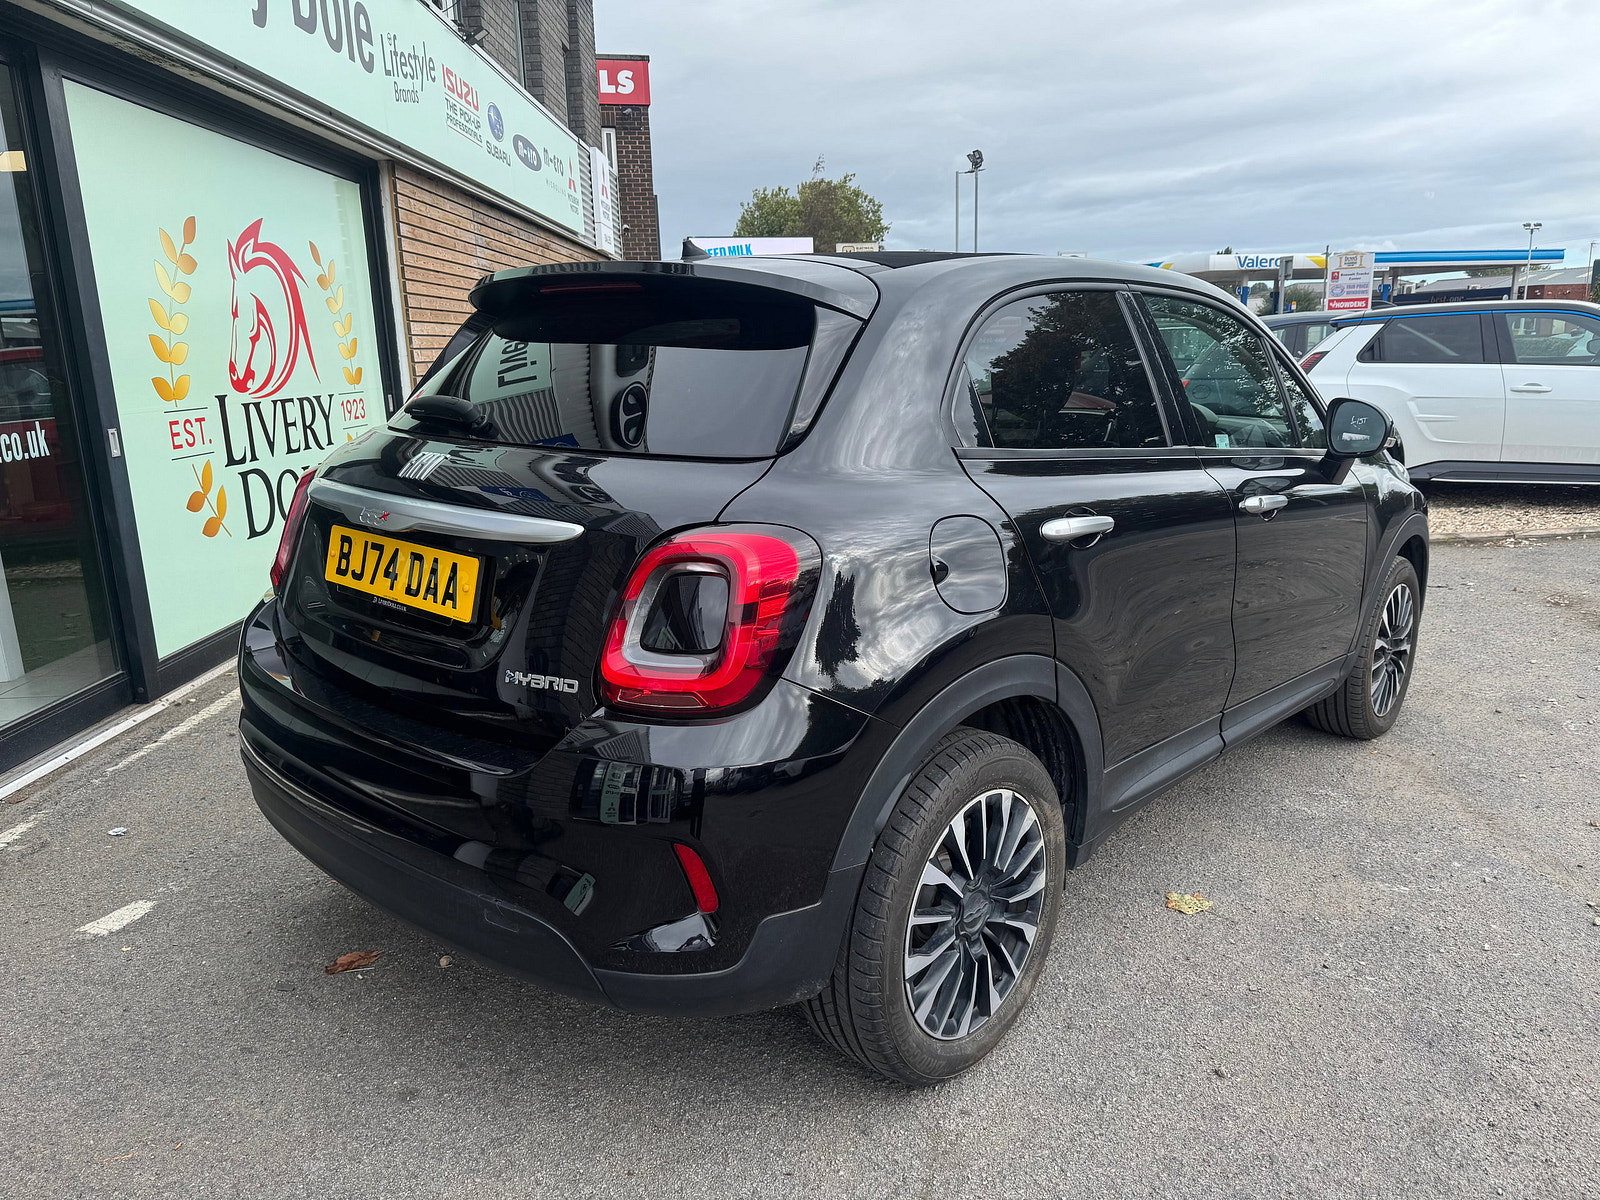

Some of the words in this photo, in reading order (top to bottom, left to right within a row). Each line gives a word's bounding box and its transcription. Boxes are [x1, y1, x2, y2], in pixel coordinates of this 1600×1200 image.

[380, 32, 436, 92] Lifestyle
[393, 81, 419, 104] Brands
[442, 63, 479, 112] ISUZU
[445, 97, 458, 117] THE
[460, 107, 481, 131] PICK-UP
[486, 139, 511, 167] SUBARU
[728, 243, 752, 256] MILK
[340, 397, 366, 422] 1923
[0, 420, 51, 464] .co.uk
[168, 417, 213, 450] EST.
[214, 393, 335, 468] LIVERY
[238, 464, 311, 540] DO
[335, 534, 400, 591] BJ74
[404, 551, 459, 610] DAA
[504, 669, 579, 694] HYBRID
